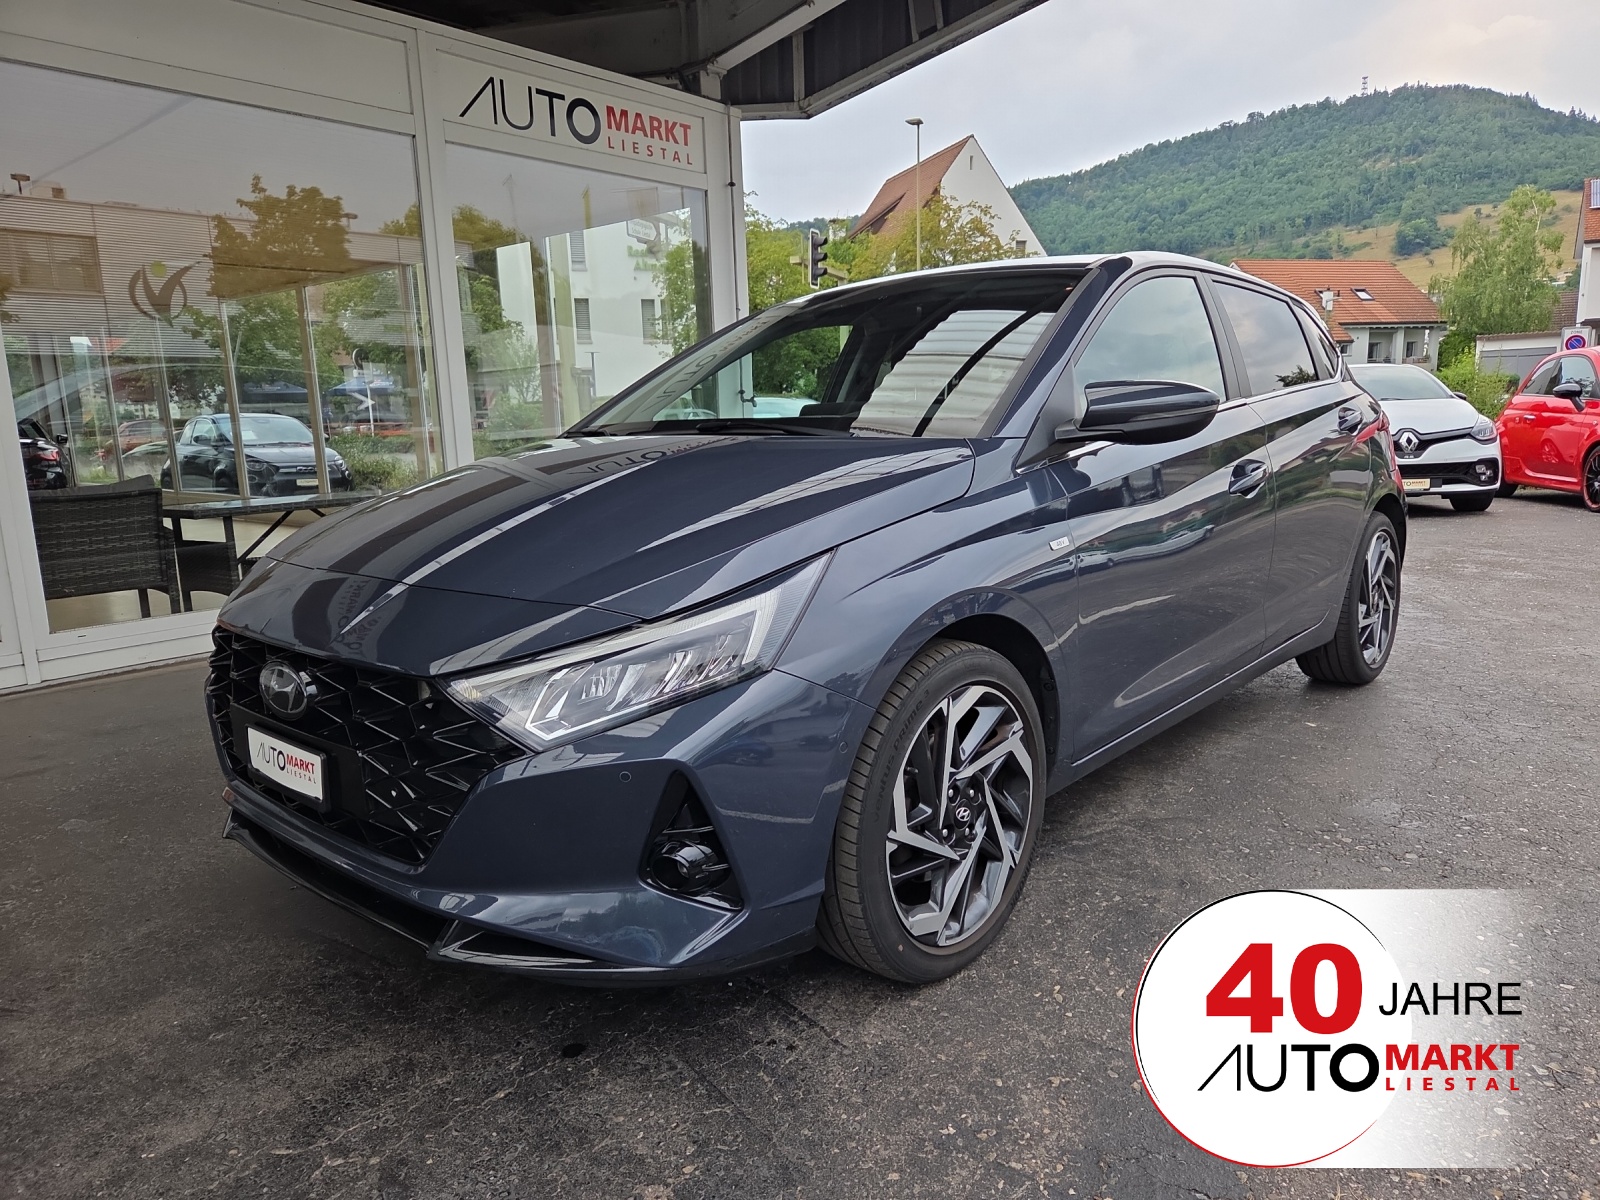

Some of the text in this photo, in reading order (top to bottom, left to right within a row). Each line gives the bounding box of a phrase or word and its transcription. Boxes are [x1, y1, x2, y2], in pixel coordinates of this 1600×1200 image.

[458, 76, 691, 147] AUTO MARKT
[607, 136, 693, 165] LIESTAL
[256, 742, 315, 775] AUTO MARKT
[286, 768, 317, 785] LIESTAL
